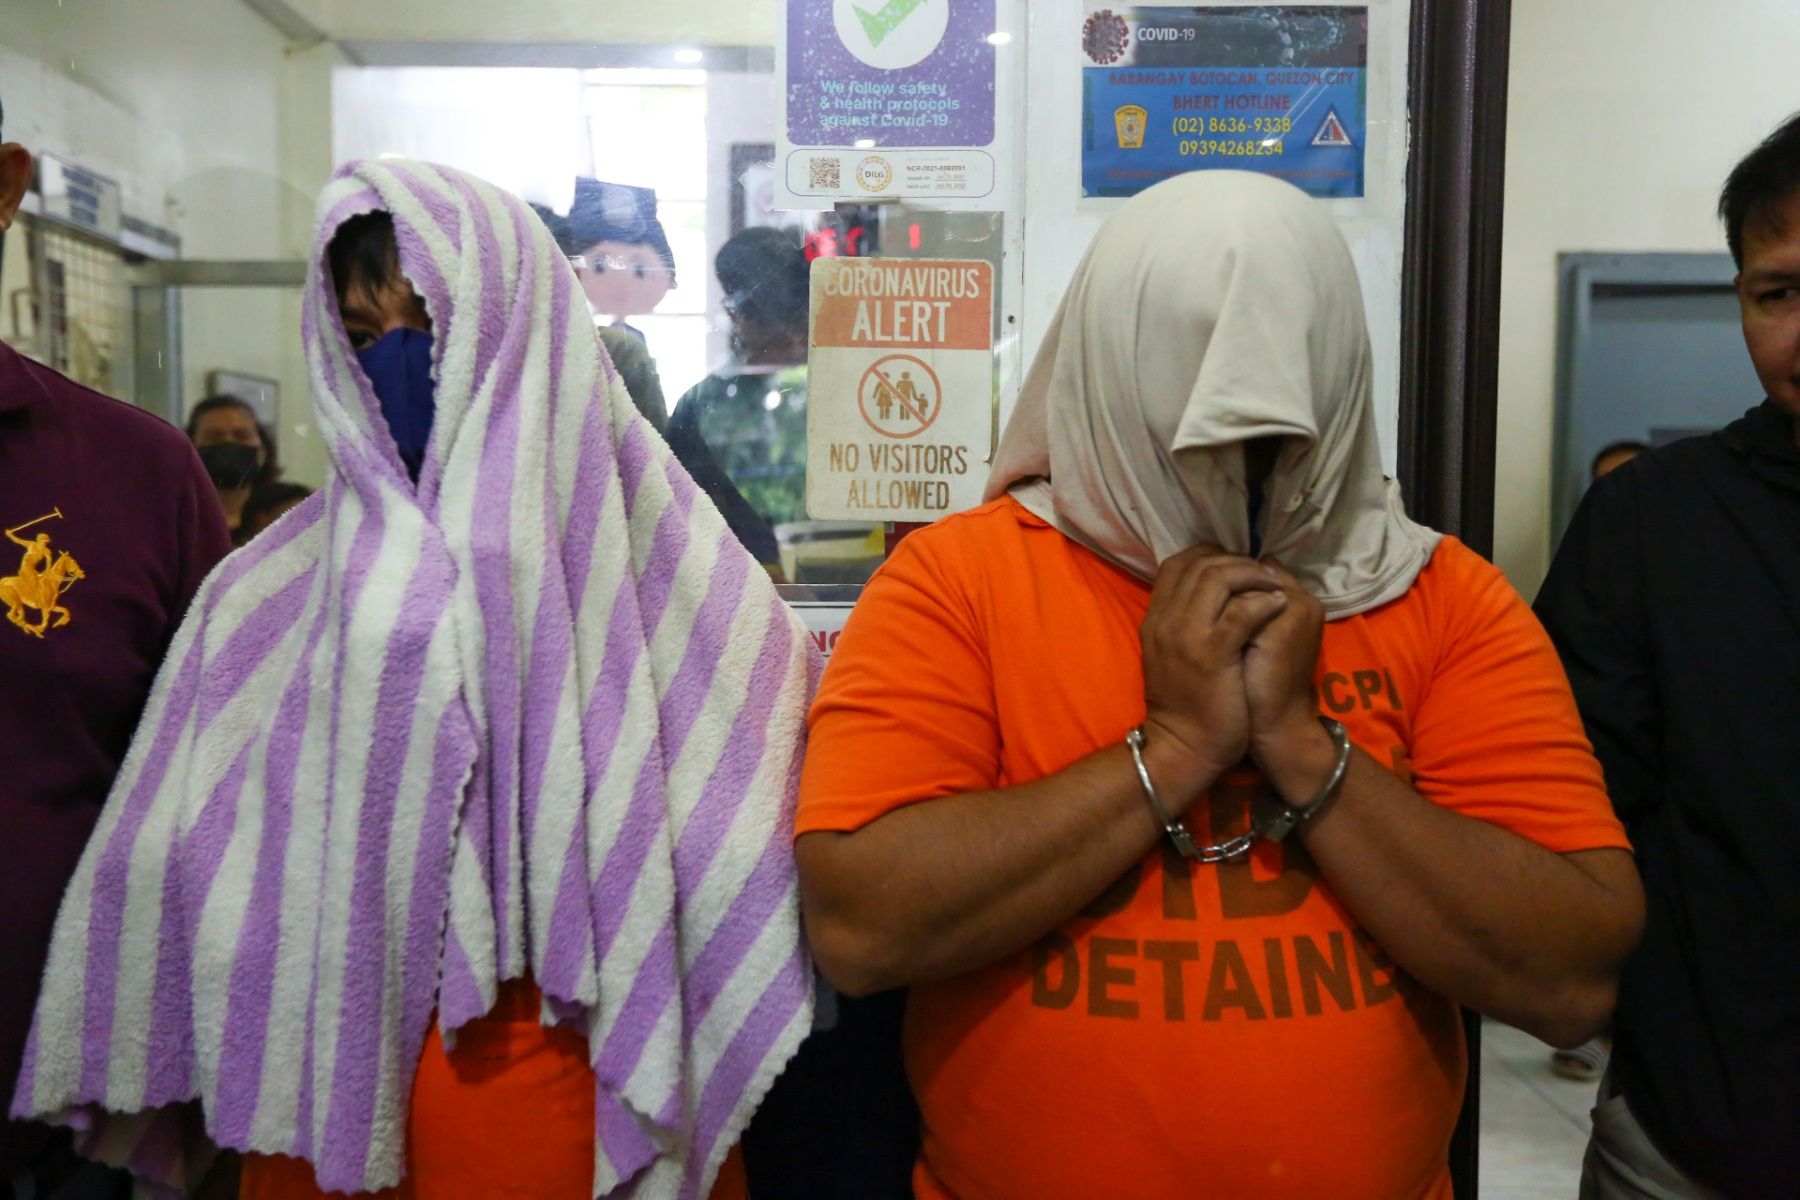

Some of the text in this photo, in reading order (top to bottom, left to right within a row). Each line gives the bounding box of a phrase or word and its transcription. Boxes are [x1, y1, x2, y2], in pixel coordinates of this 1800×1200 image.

[1137, 27, 1195, 41] COVID-19
[1109, 72, 1186, 86] BARANGAY
[1266, 72, 1321, 85] QUEZON
[1326, 71, 1355, 85] CITY
[820, 80, 947, 97] We follow safety
[819, 96, 961, 113] & health protocols
[1173, 95, 1290, 111] BHERT HOTLINE
[820, 113, 949, 129] against Covid-19
[1172, 117, 1291, 136] (02) 8636-9338
[824, 266, 980, 298] CORONAVIRUS
[851, 301, 951, 343] ALERT
[829, 443, 968, 476] NO VISITORS
[847, 480, 950, 511] ALLOWED
